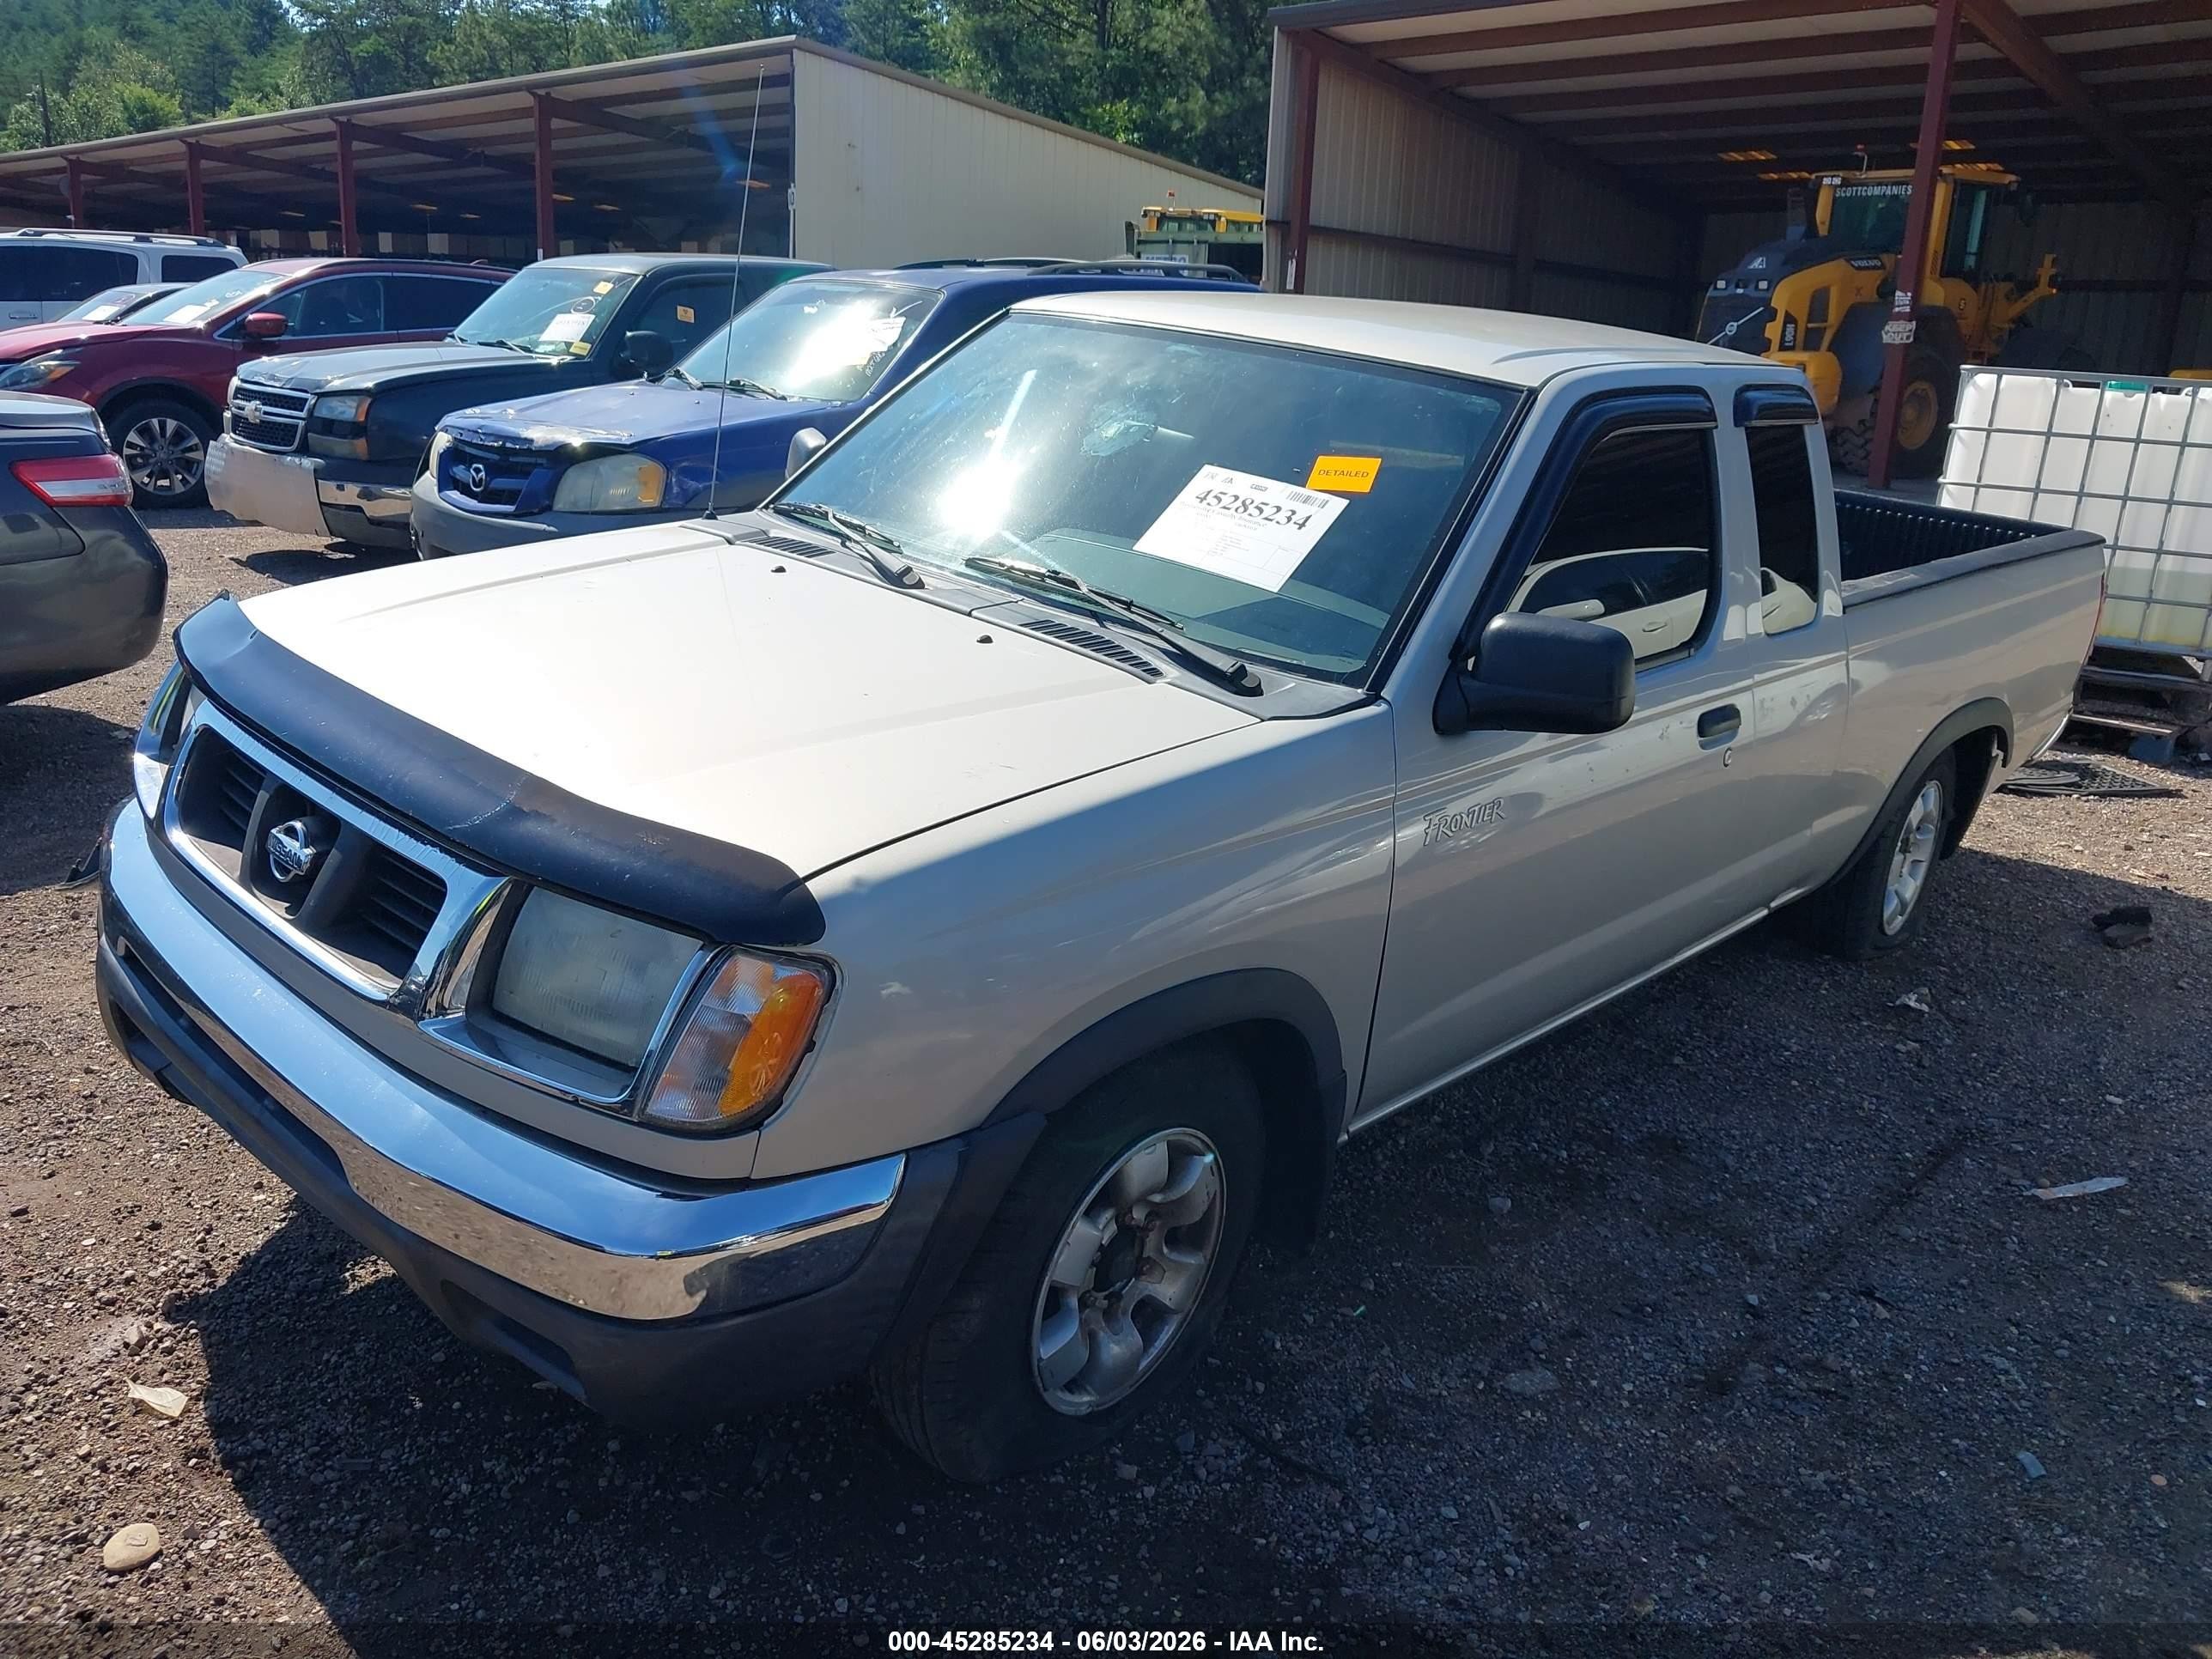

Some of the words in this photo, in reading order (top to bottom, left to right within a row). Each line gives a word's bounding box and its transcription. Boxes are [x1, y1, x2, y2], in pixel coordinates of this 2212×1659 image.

[1835, 185, 1913, 198] SCOTTCOMPANIES
[1850, 258, 1882, 268] VOLVO
[1318, 469, 1369, 477] DETAILED
[1195, 489, 1313, 531] 45285234
[1423, 797, 1506, 847] FRONTIER
[268, 832, 303, 871] NISSAN
